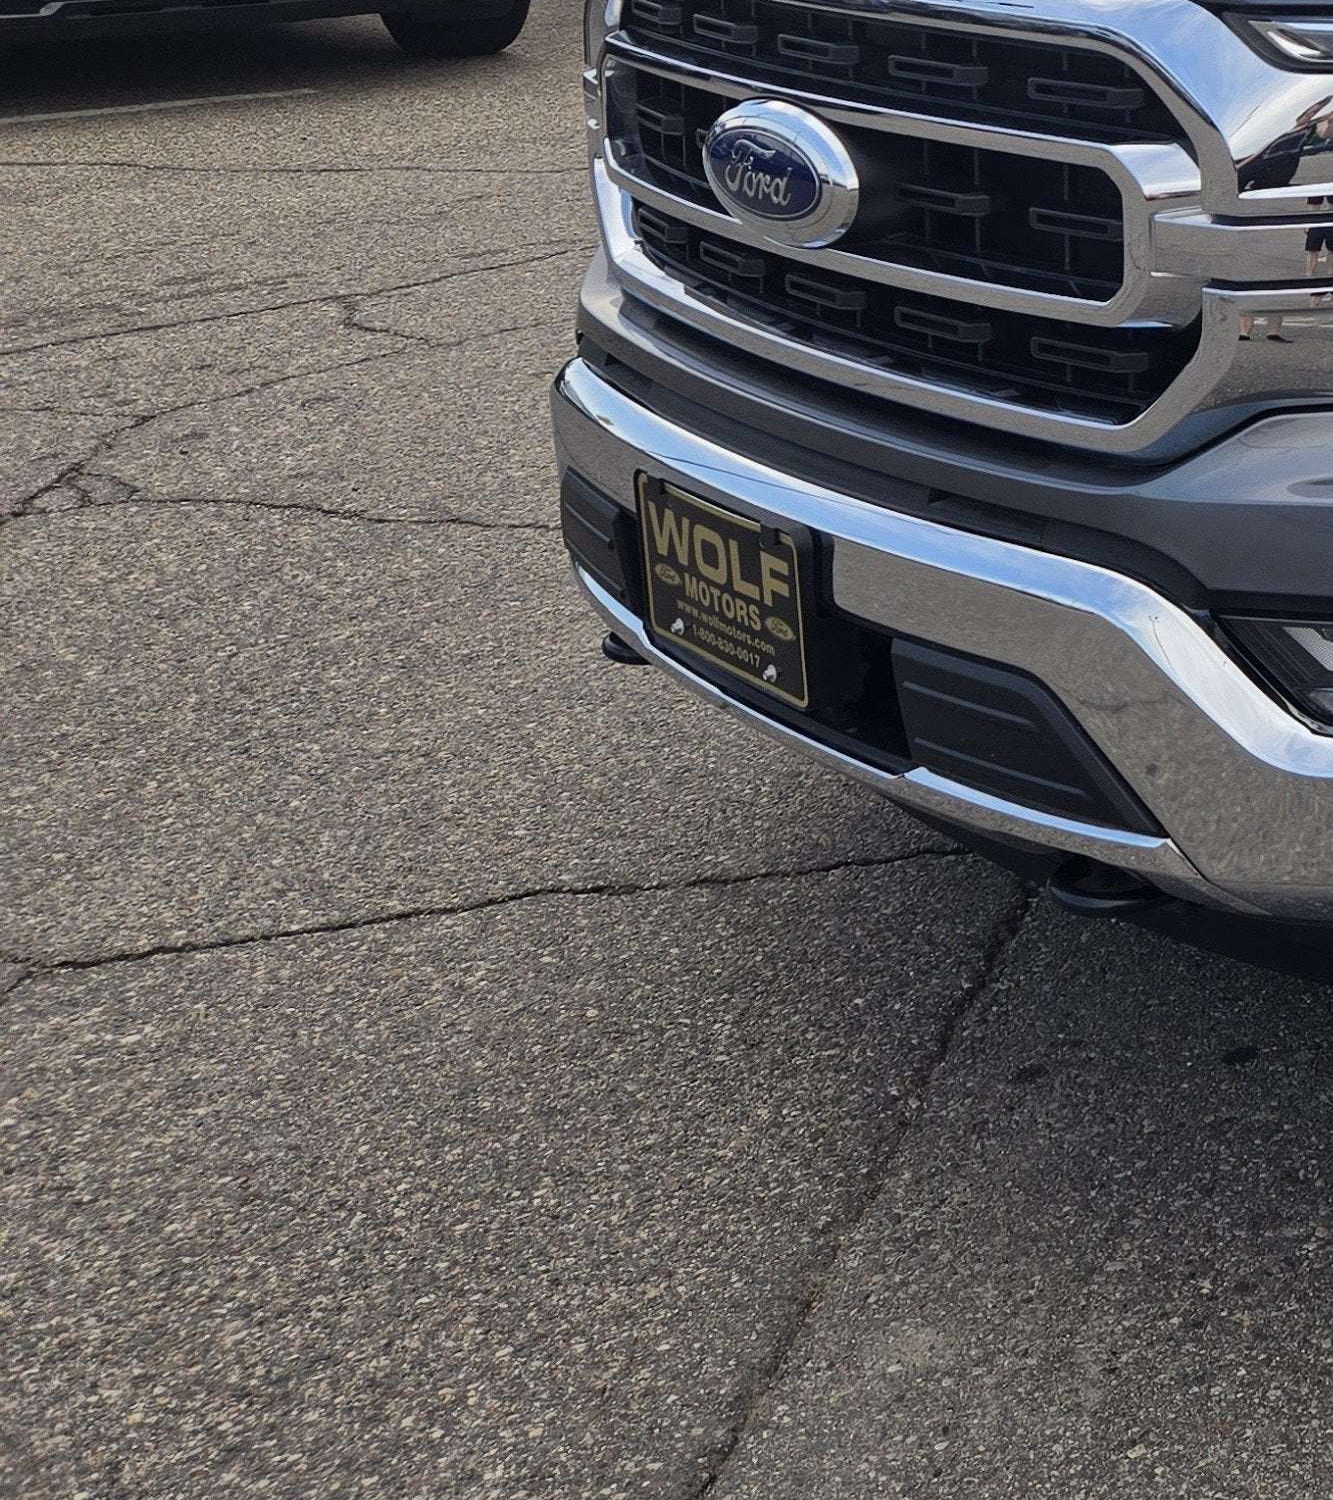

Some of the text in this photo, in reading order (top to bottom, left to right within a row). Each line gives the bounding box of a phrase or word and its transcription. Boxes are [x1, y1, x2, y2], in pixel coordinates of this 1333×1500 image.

[725, 138, 793, 206] Ford
[648, 499, 790, 607] WOLF
[676, 599, 776, 656] www.wolfmotors.com
[683, 572, 762, 631] MOTORS
[692, 624, 760, 668] 1-800-830-0017
